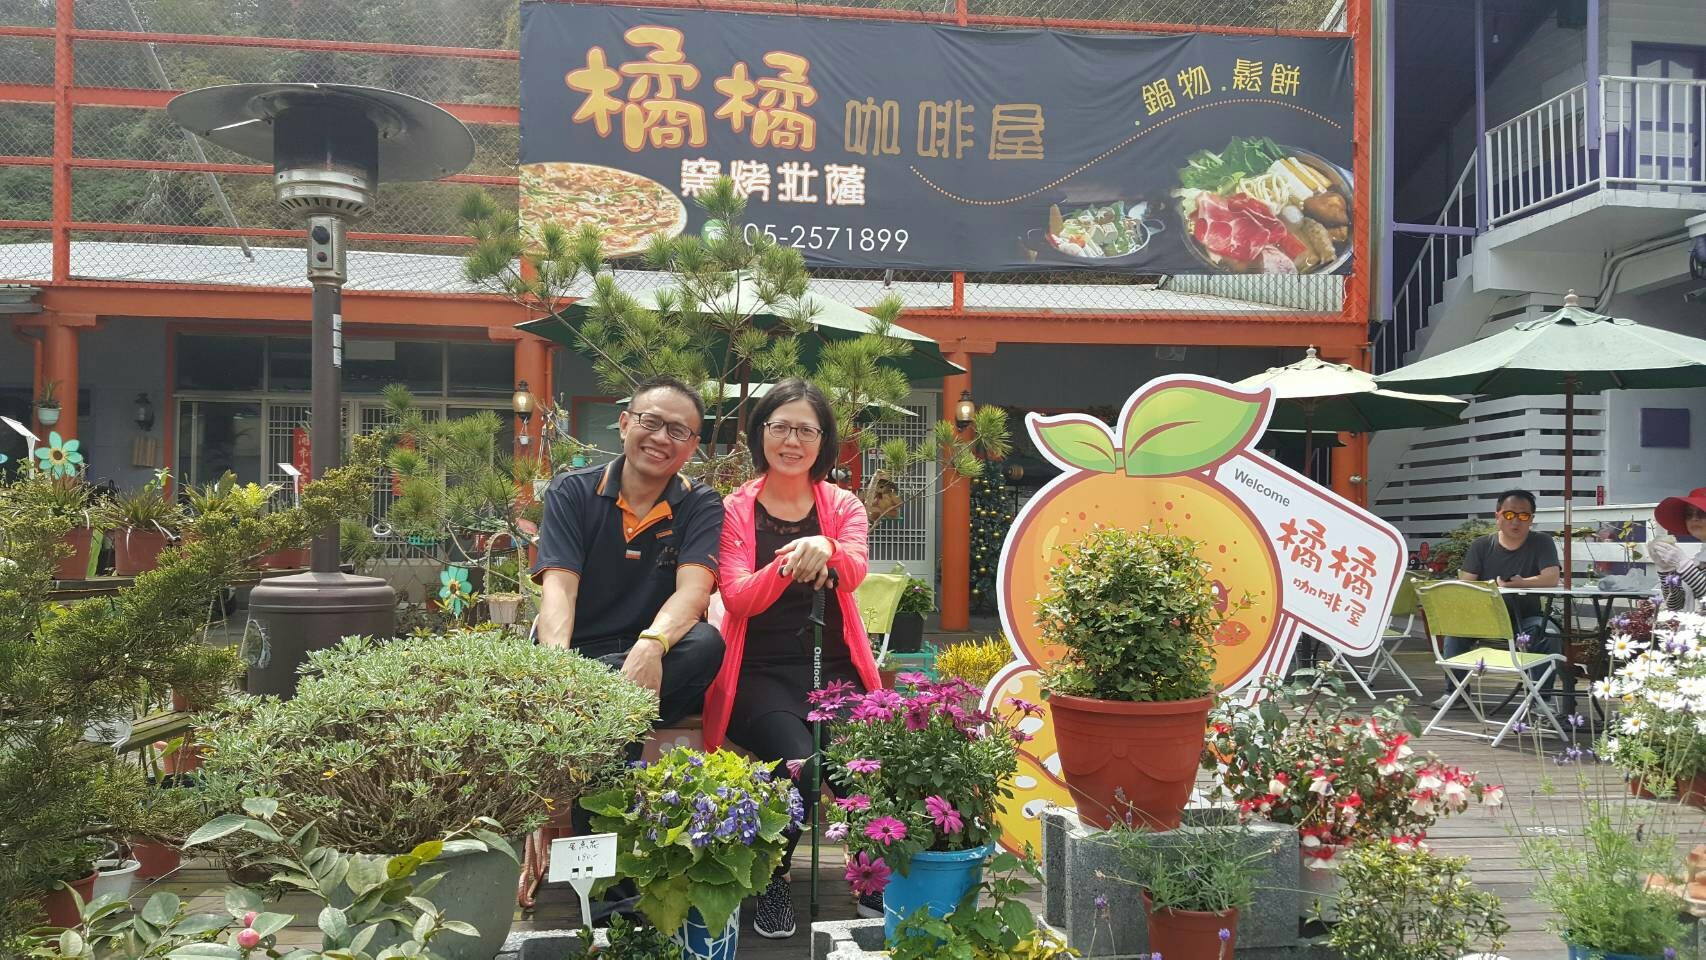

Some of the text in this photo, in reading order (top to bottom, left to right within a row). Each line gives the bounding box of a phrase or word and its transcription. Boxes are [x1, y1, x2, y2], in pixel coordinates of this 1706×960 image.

[565, 25, 1045, 160] 橘橘 咖啡屋
[743, 223, 909, 252] 05-2571899
[1234, 468, 1290, 507] Welcome
[1276, 518, 1377, 600] 橘橘
[1293, 577, 1367, 627] 咖啡屋
[813, 646, 822, 689] Outlook
